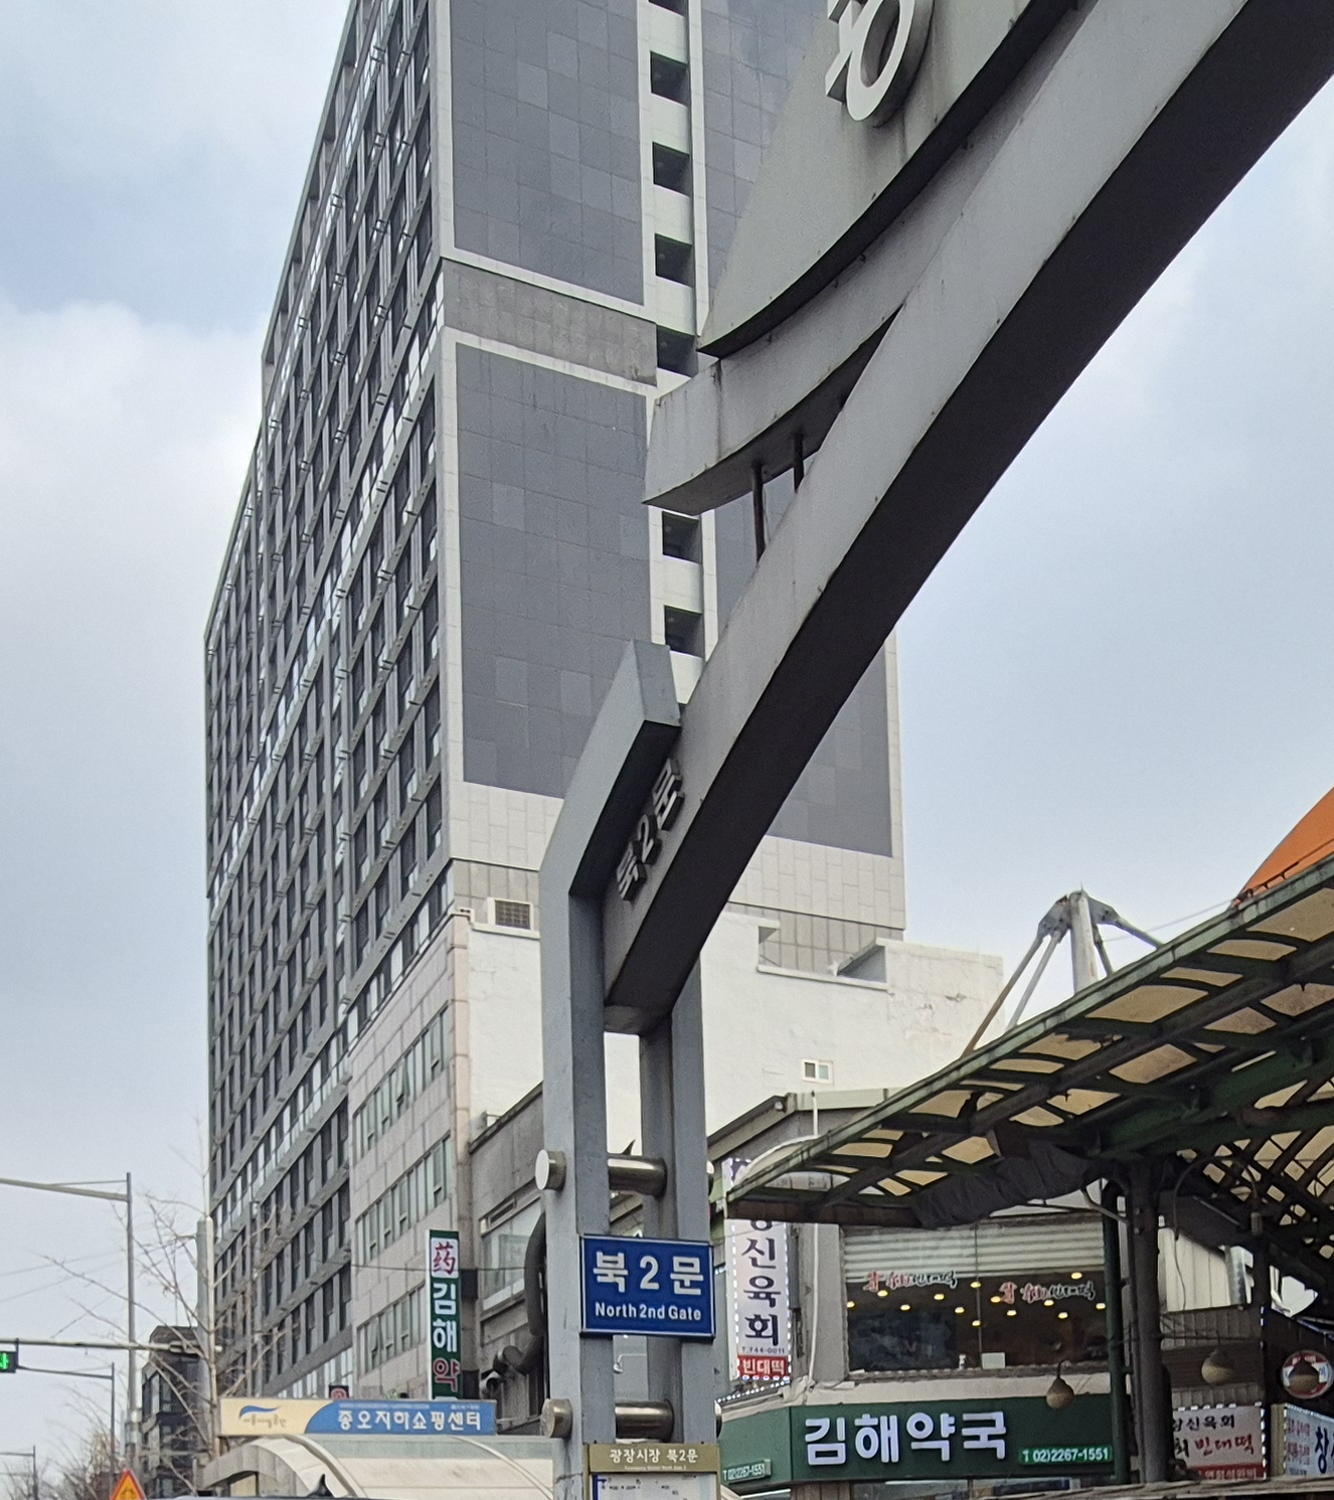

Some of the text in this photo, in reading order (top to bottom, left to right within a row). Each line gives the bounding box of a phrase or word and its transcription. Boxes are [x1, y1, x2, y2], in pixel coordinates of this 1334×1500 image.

[616, 757, 685, 901] 북2문
[432, 1241, 456, 1275] 药
[741, 1220, 782, 1347] 신육회
[595, 1302, 701, 1320] North 2nd Gate
[432, 1282, 460, 1400] 김해약
[742, 1359, 785, 1375] 빈대떡
[804, 1411, 1008, 1466] 김해약국
[1032, 1448, 1109, 1463] 02)2267-1551
[609, 1449, 698, 1463] 광장시장 북2문
